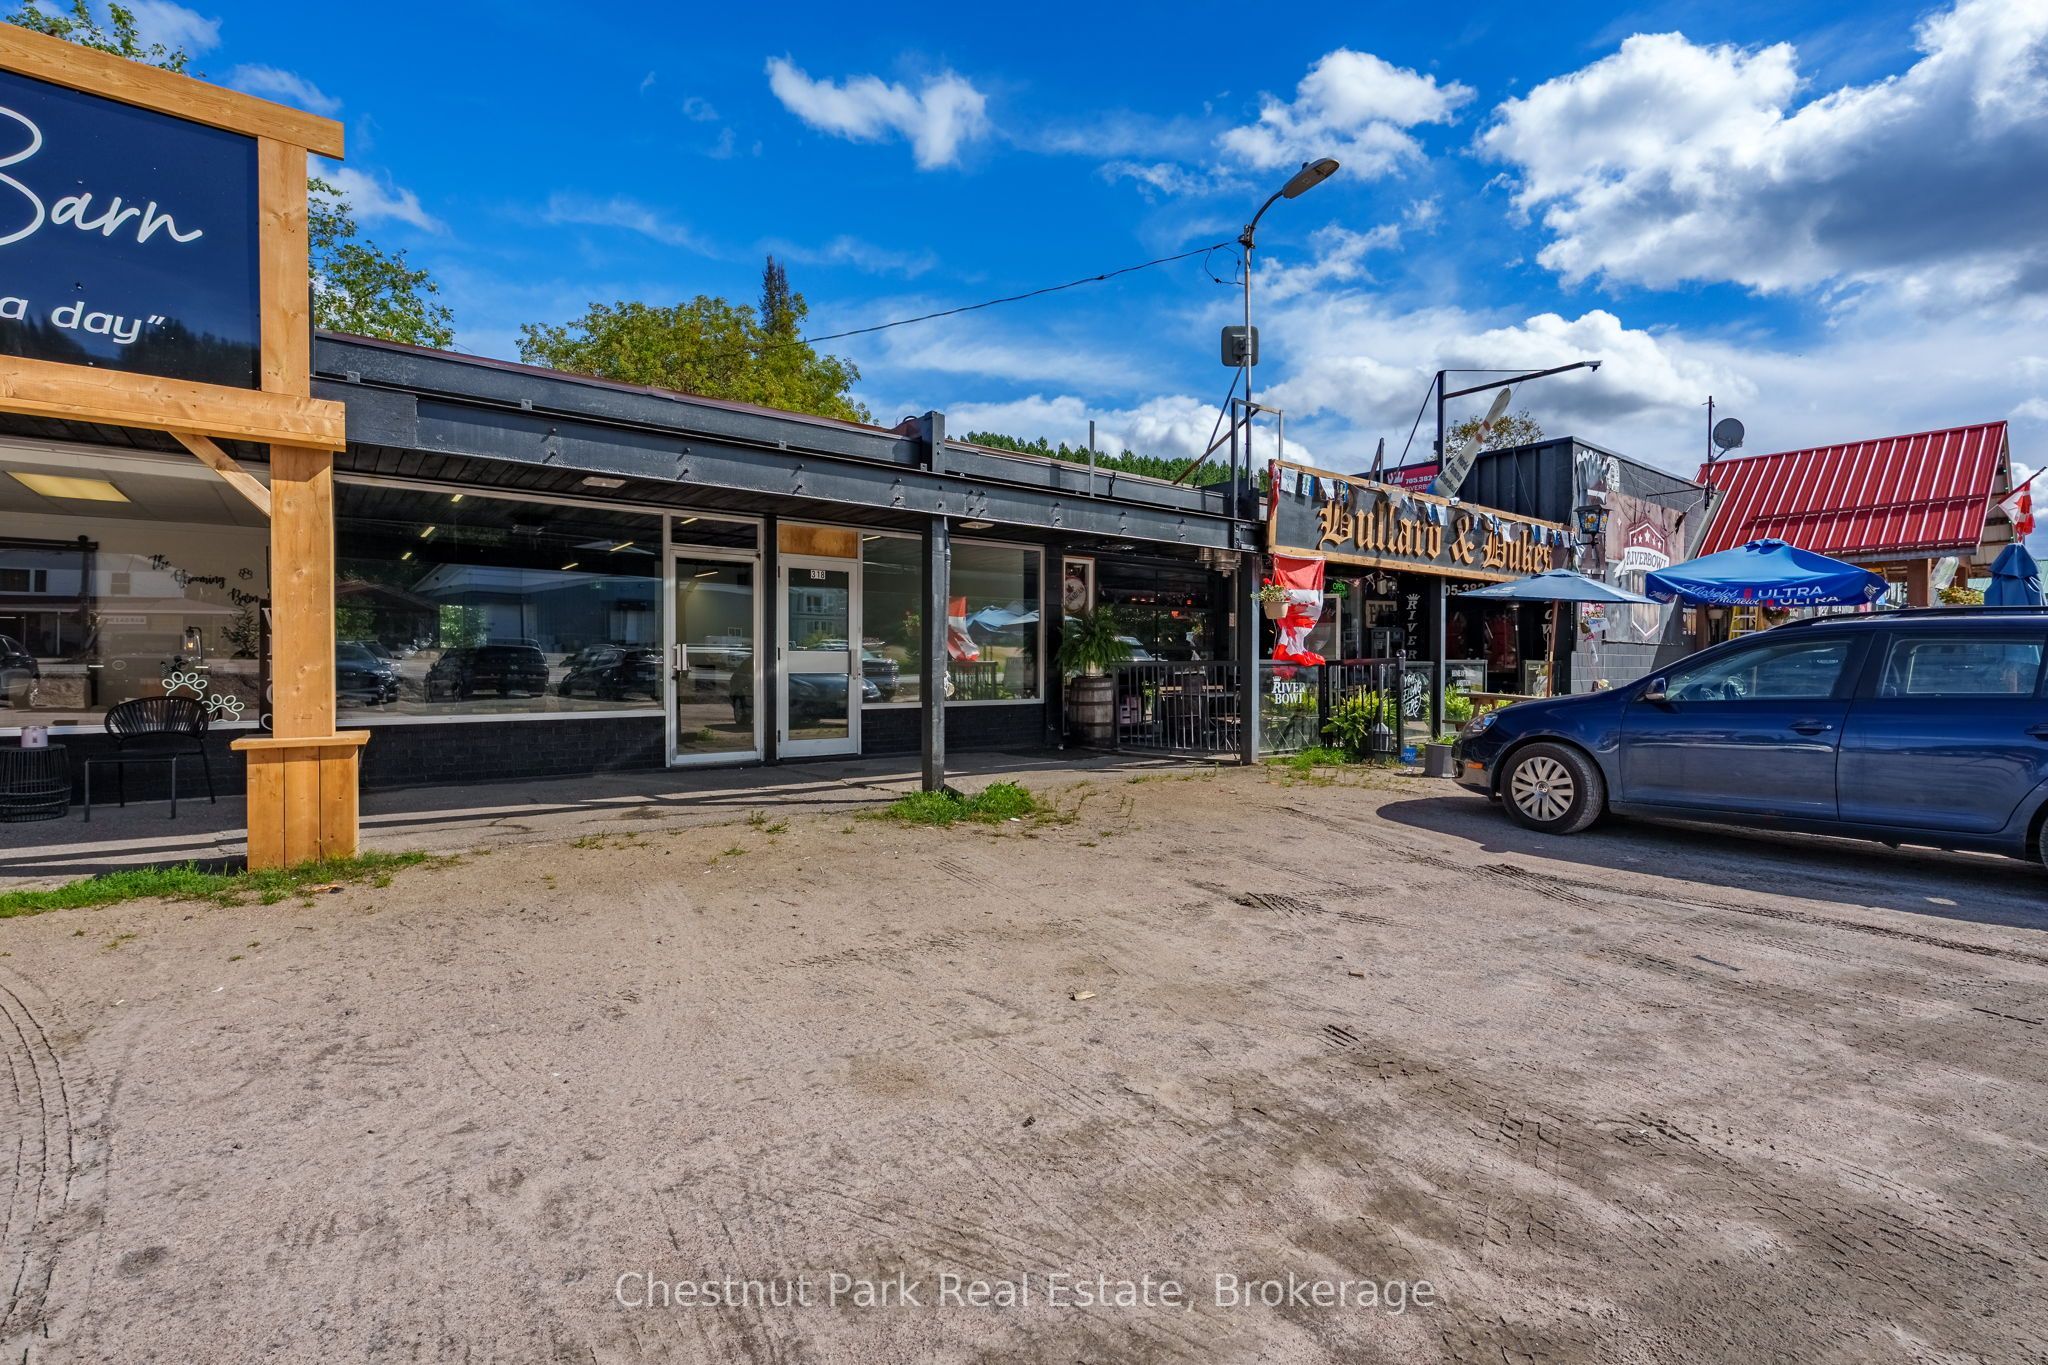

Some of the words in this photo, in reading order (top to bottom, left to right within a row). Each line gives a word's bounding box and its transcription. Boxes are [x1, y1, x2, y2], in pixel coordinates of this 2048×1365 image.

[1451, 514, 1475, 564] &
[171, 569, 225, 589] Grooming
[811, 570, 825, 579] 318
[1758, 586, 1824, 599] ULTRA
[1406, 600, 1418, 660] RIVER
[1272, 681, 1306, 694] RIVER
